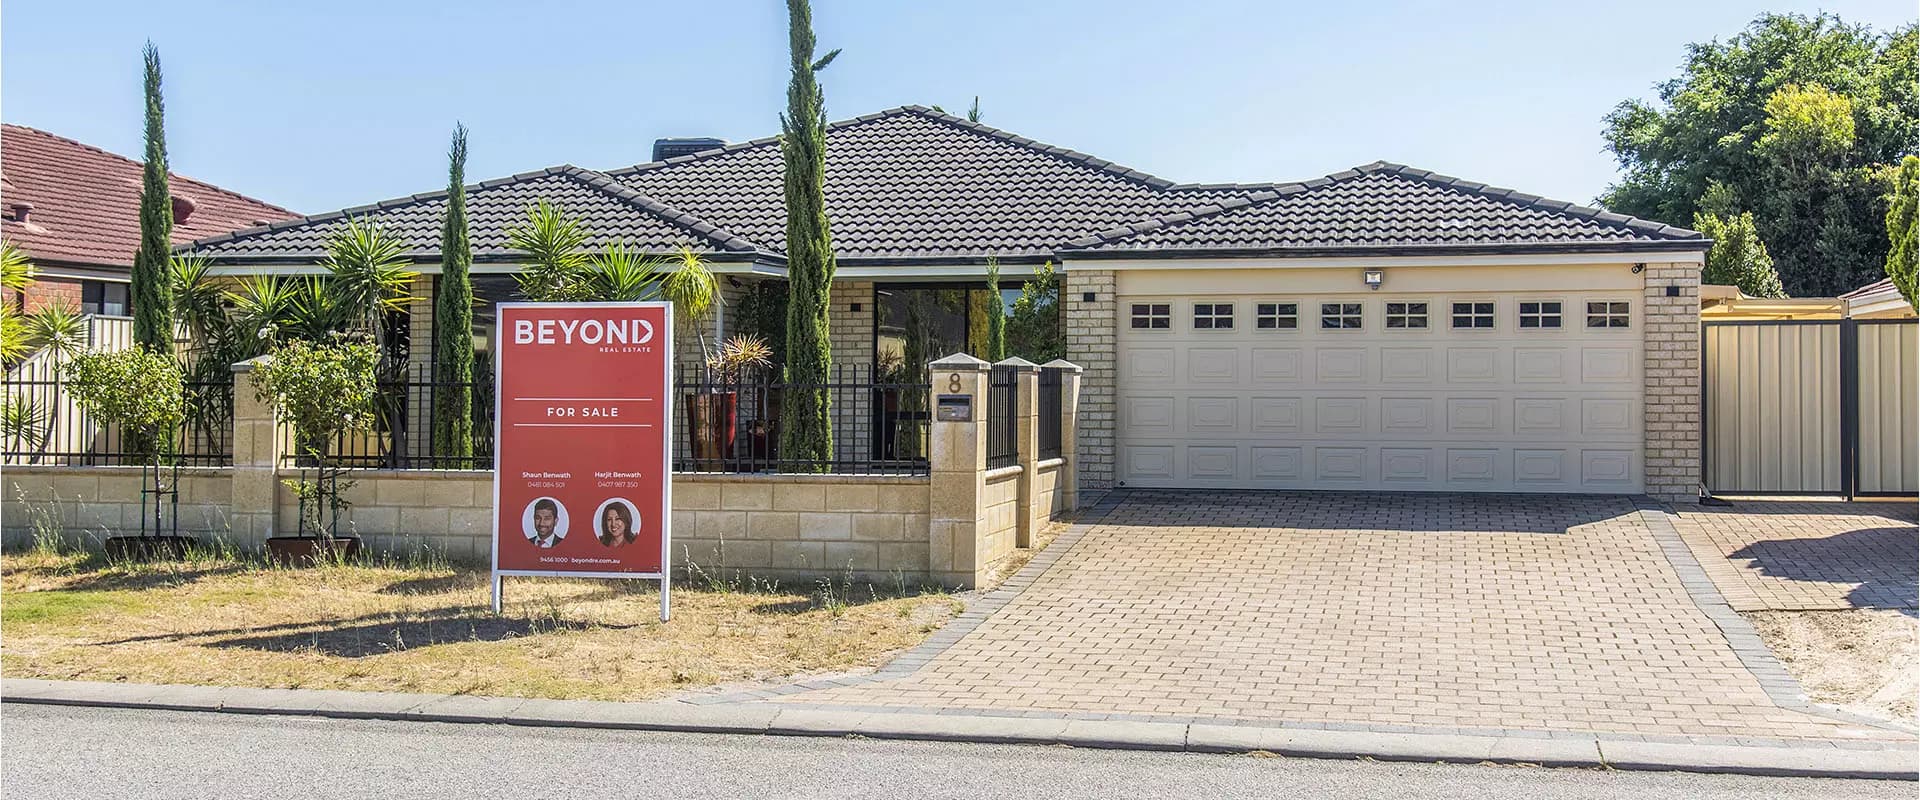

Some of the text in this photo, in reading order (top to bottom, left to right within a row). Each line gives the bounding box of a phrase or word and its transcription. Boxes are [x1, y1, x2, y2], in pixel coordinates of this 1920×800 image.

[515, 319, 654, 345] BEYOND
[949, 373, 961, 393] 8
[547, 407, 619, 417] FOR SALE
[522, 471, 571, 479] Shaun Benwath
[594, 471, 642, 480] Harjit Benwath
[571, 557, 620, 565] beyondre.com.au
